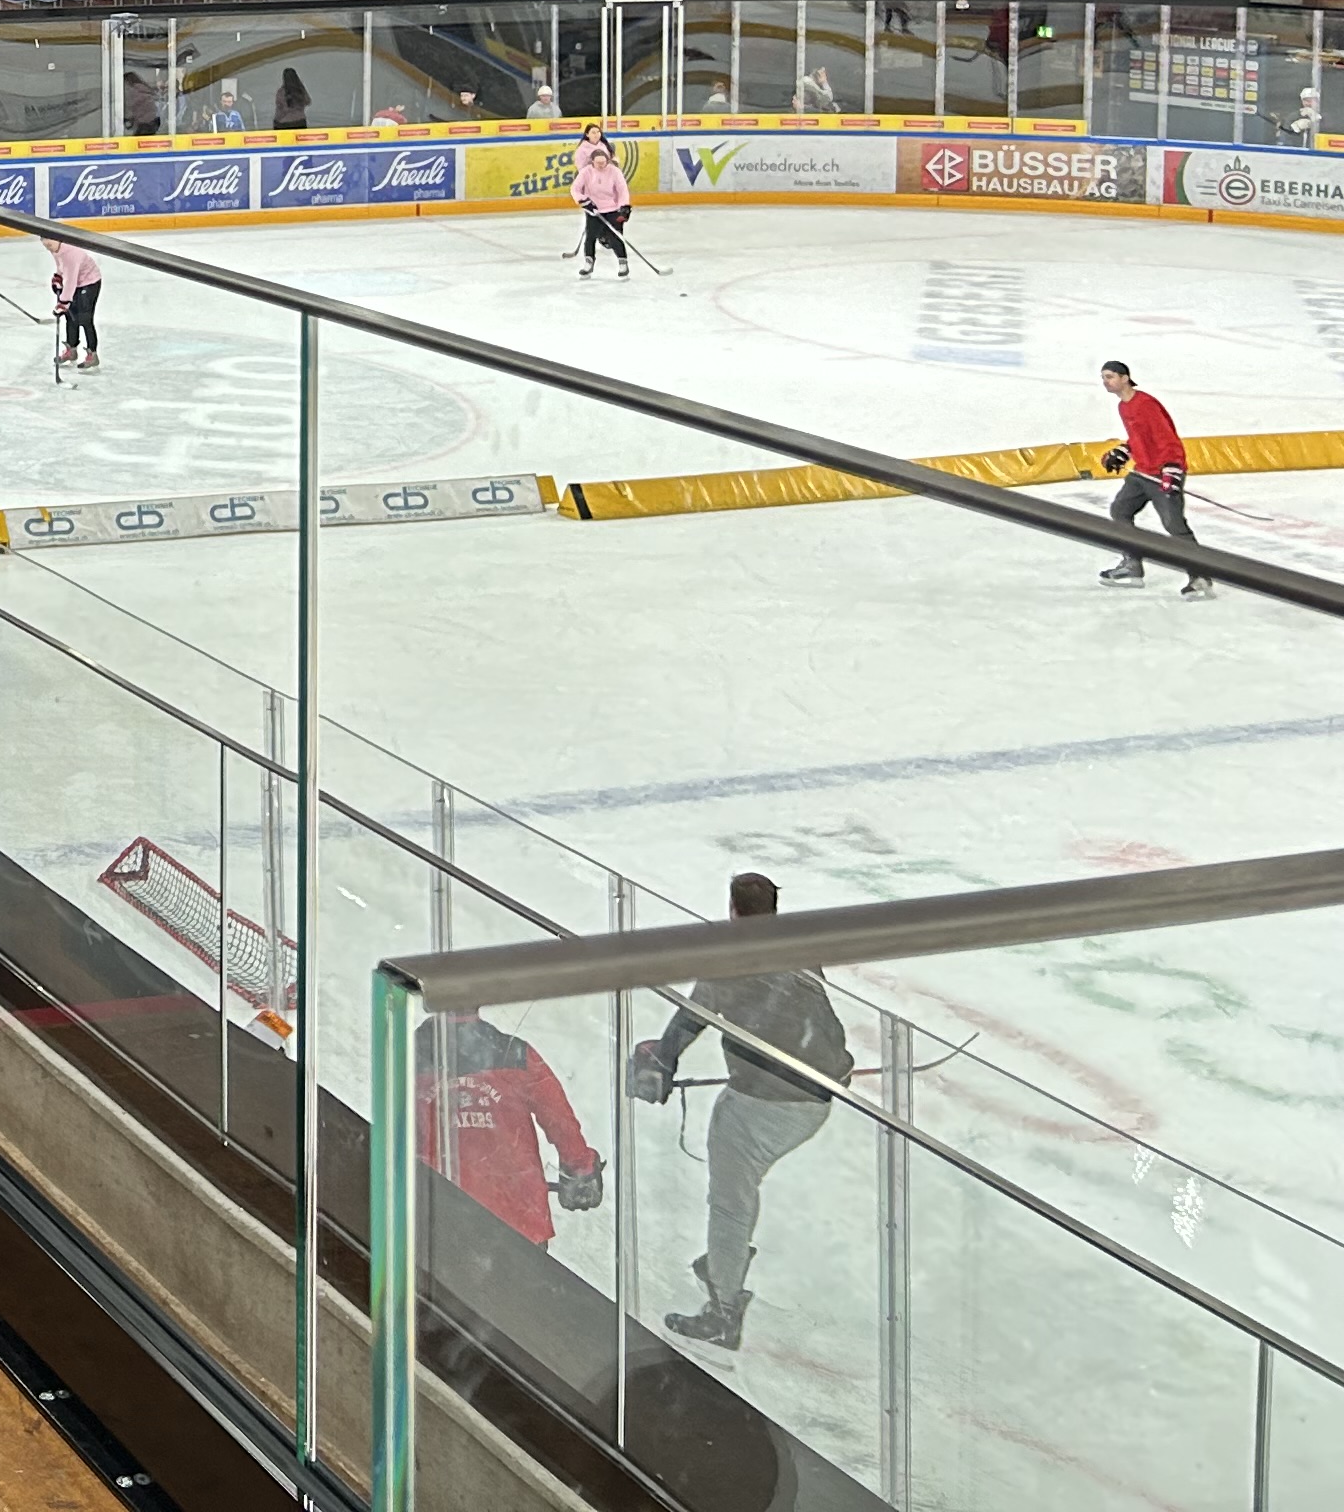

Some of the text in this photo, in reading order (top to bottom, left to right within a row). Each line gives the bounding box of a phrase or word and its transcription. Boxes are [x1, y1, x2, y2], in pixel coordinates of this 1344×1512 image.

[163, 160, 243, 202] Streuli
[268, 156, 347, 197] Streuli
[371, 151, 448, 192] Streuli
[734, 158, 840, 173] werbedruck.ch
[972, 145, 1118, 180] BÜSSER
[57, 166, 137, 207] Streuli
[972, 177, 1118, 198] HAUSBAU AG
